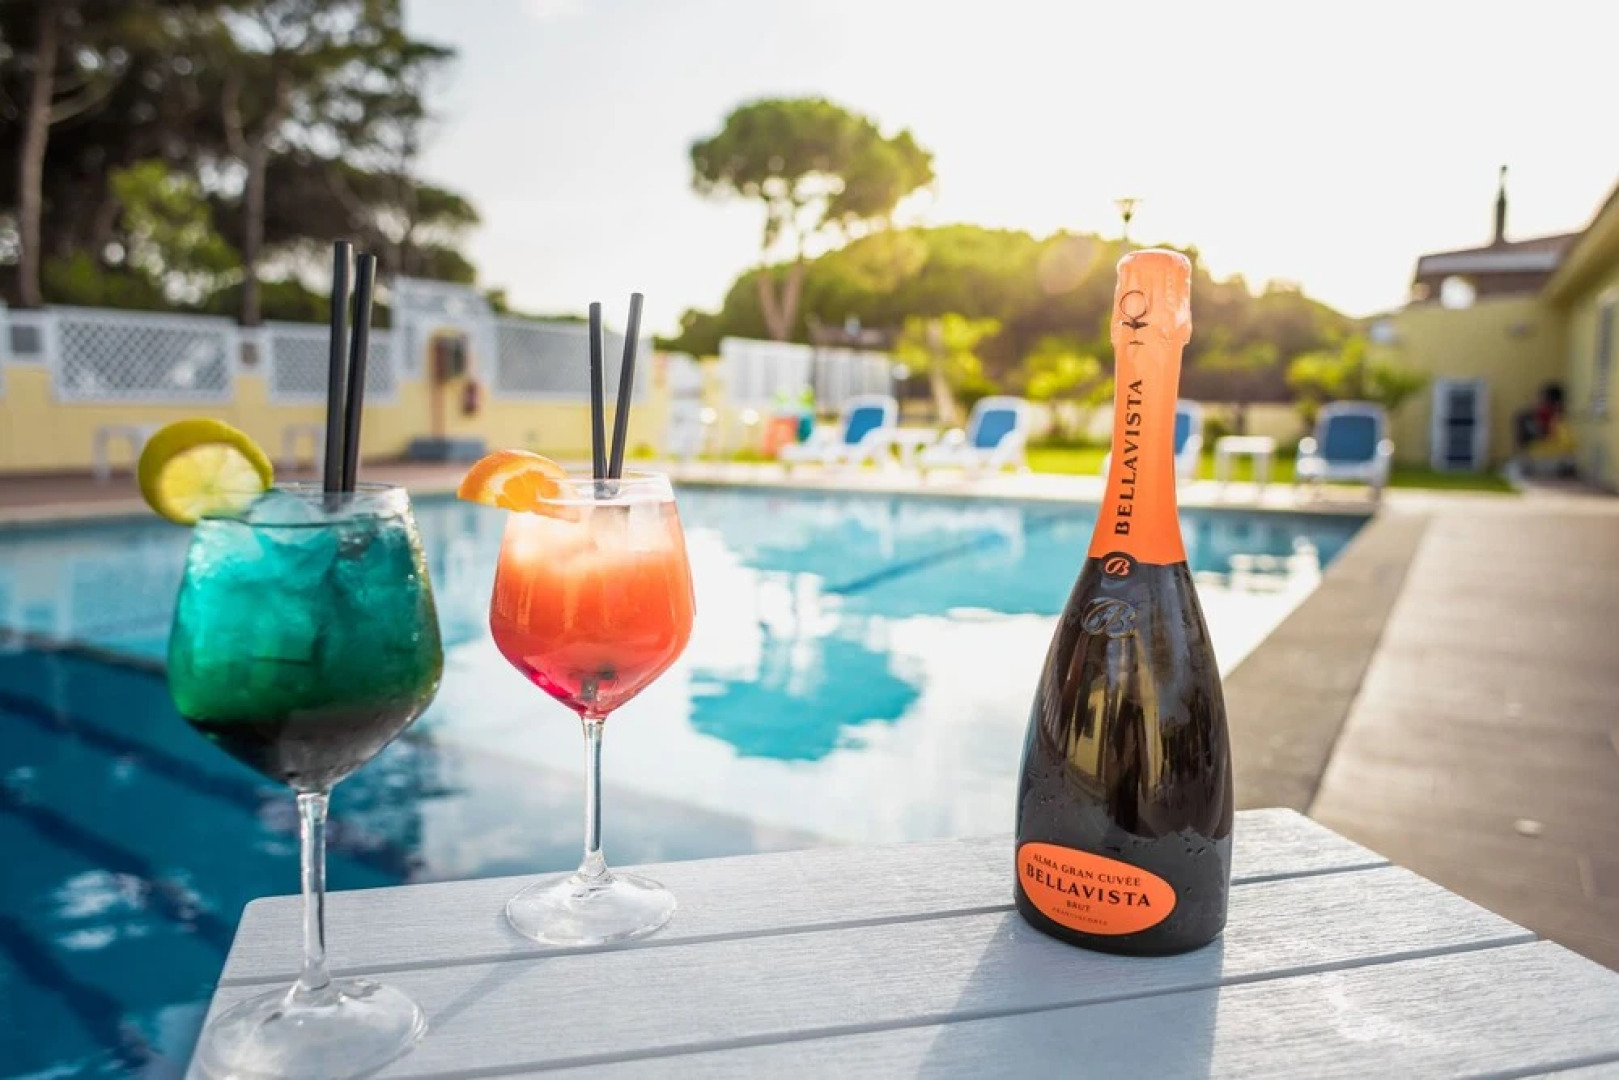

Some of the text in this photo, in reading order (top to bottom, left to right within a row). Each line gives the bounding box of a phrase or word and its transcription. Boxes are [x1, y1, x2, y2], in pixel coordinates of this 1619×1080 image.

[1114, 379, 1142, 536] BELLAVISTA
[1026, 862, 1151, 907] BELLAVISTA
[1033, 853, 1058, 870] ALMA
[1061, 864, 1094, 880] GRAN
[1066, 900, 1091, 912] BRUT
